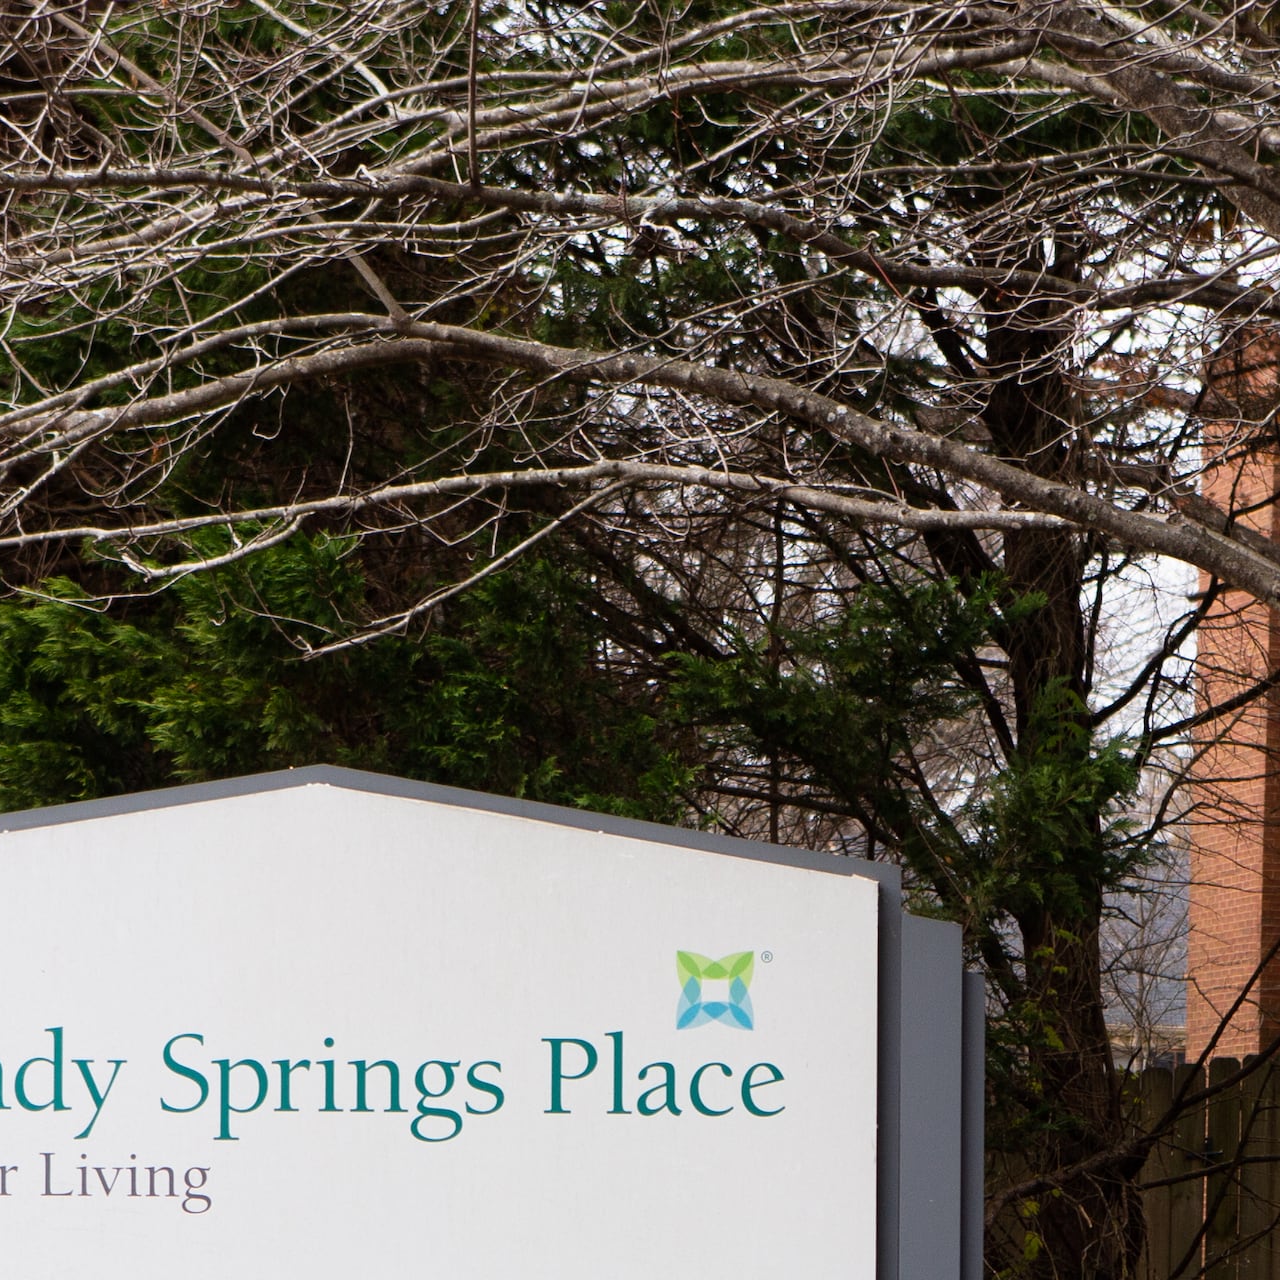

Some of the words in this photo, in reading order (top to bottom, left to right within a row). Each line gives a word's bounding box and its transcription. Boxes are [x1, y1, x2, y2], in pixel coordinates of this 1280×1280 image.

[160, 1033, 505, 1143] Springs
[541, 1032, 787, 1118] Place
[39, 1152, 212, 1214] Living
